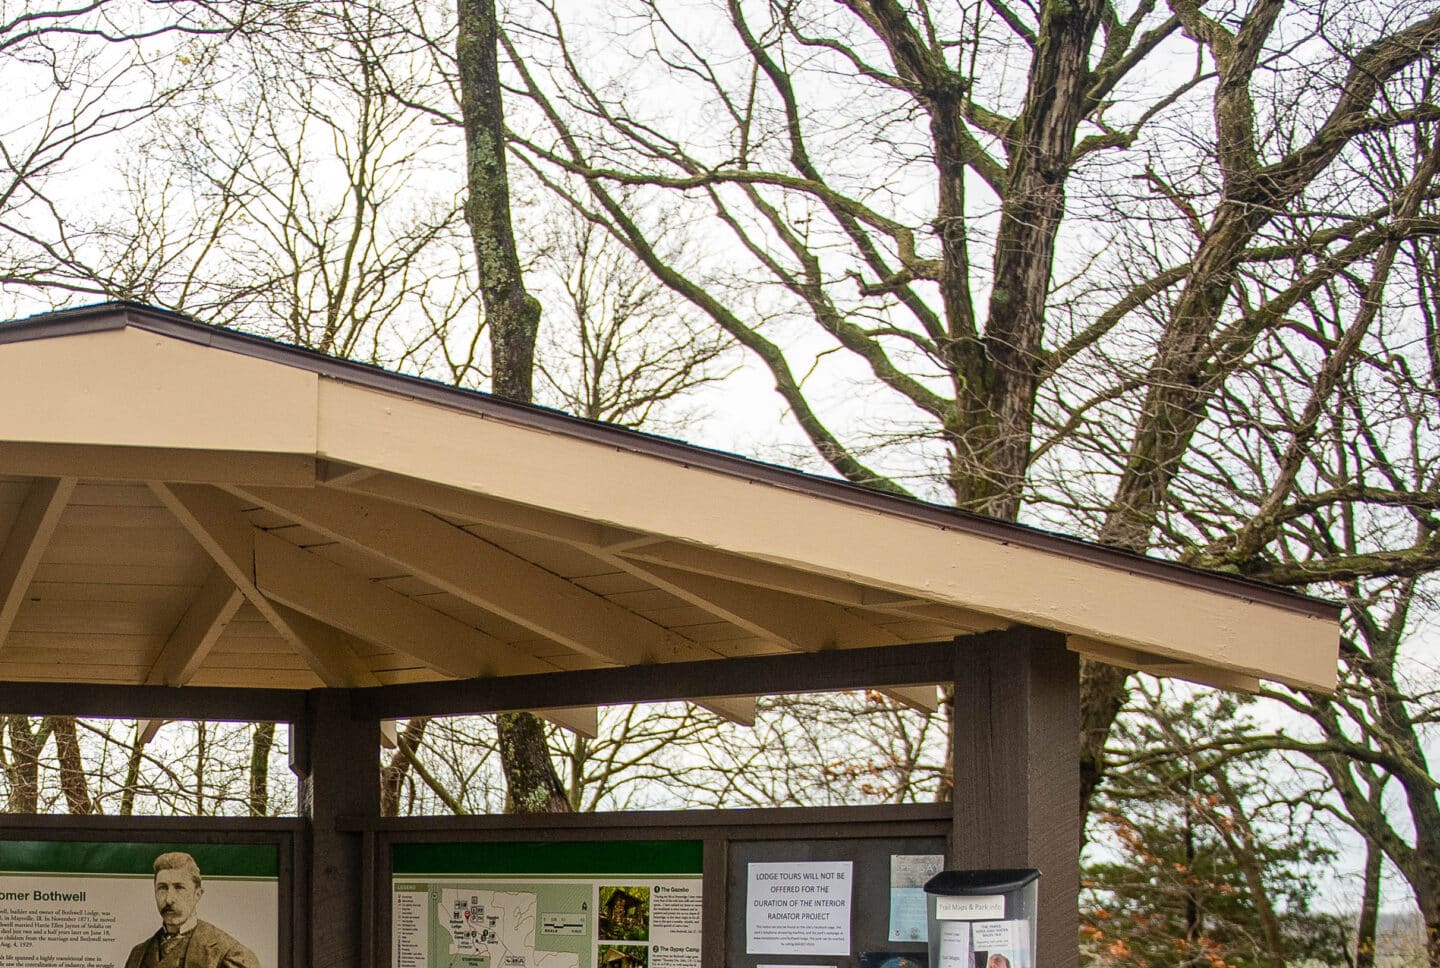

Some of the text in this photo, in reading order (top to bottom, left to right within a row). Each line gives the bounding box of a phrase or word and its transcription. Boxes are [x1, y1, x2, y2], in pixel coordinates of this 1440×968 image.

[756, 872, 778, 880] LODGE
[780, 872, 802, 880] TOURS
[33, 890, 86, 902] Bothwell
[753, 899, 845, 907] DURATION OF THE INTERIOR
[952, 904, 967, 912] Maps
[975, 903, 988, 911] Park
[768, 912, 830, 920] RADIATOR PROJECT
